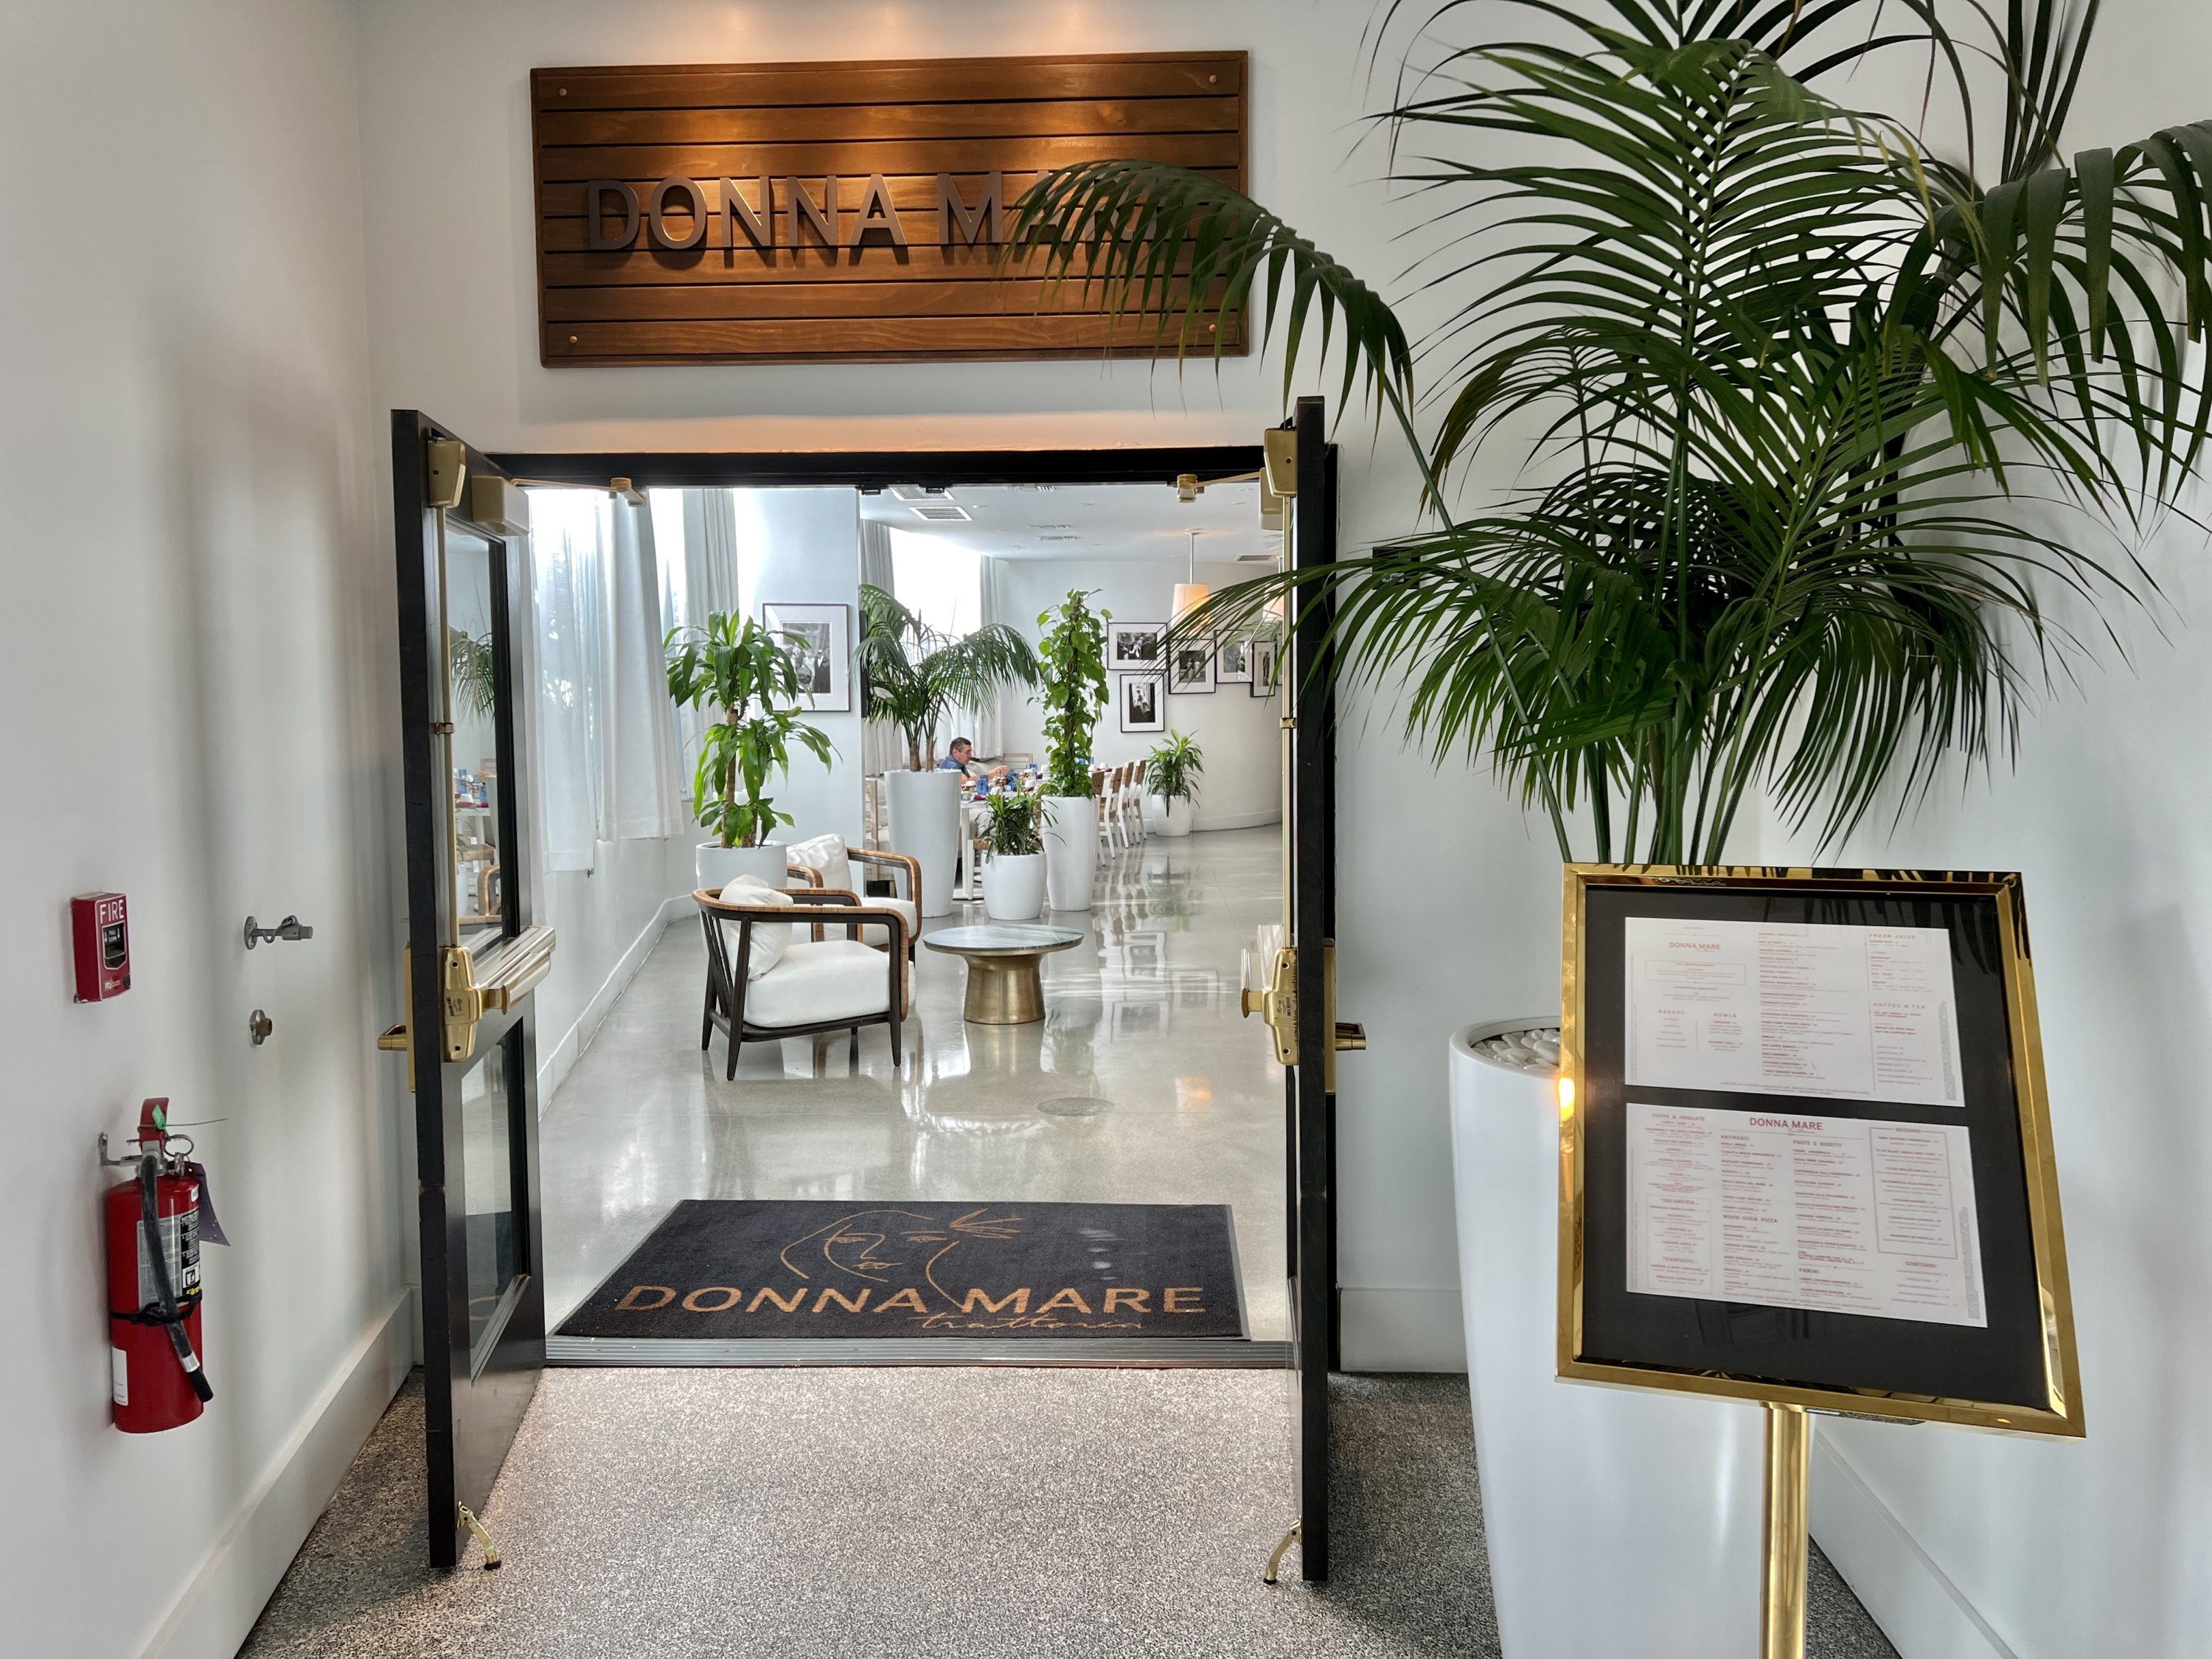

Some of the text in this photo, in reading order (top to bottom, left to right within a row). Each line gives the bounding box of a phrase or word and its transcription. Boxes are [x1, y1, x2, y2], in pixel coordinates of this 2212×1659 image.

[588, 173, 908, 249] DONNA
[100, 900, 125, 924] FIRE
[1669, 942, 1697, 950] DONNA
[1750, 1117, 1823, 1130] DONNA MARE
[614, 1285, 1206, 1314] DONNA MARE
